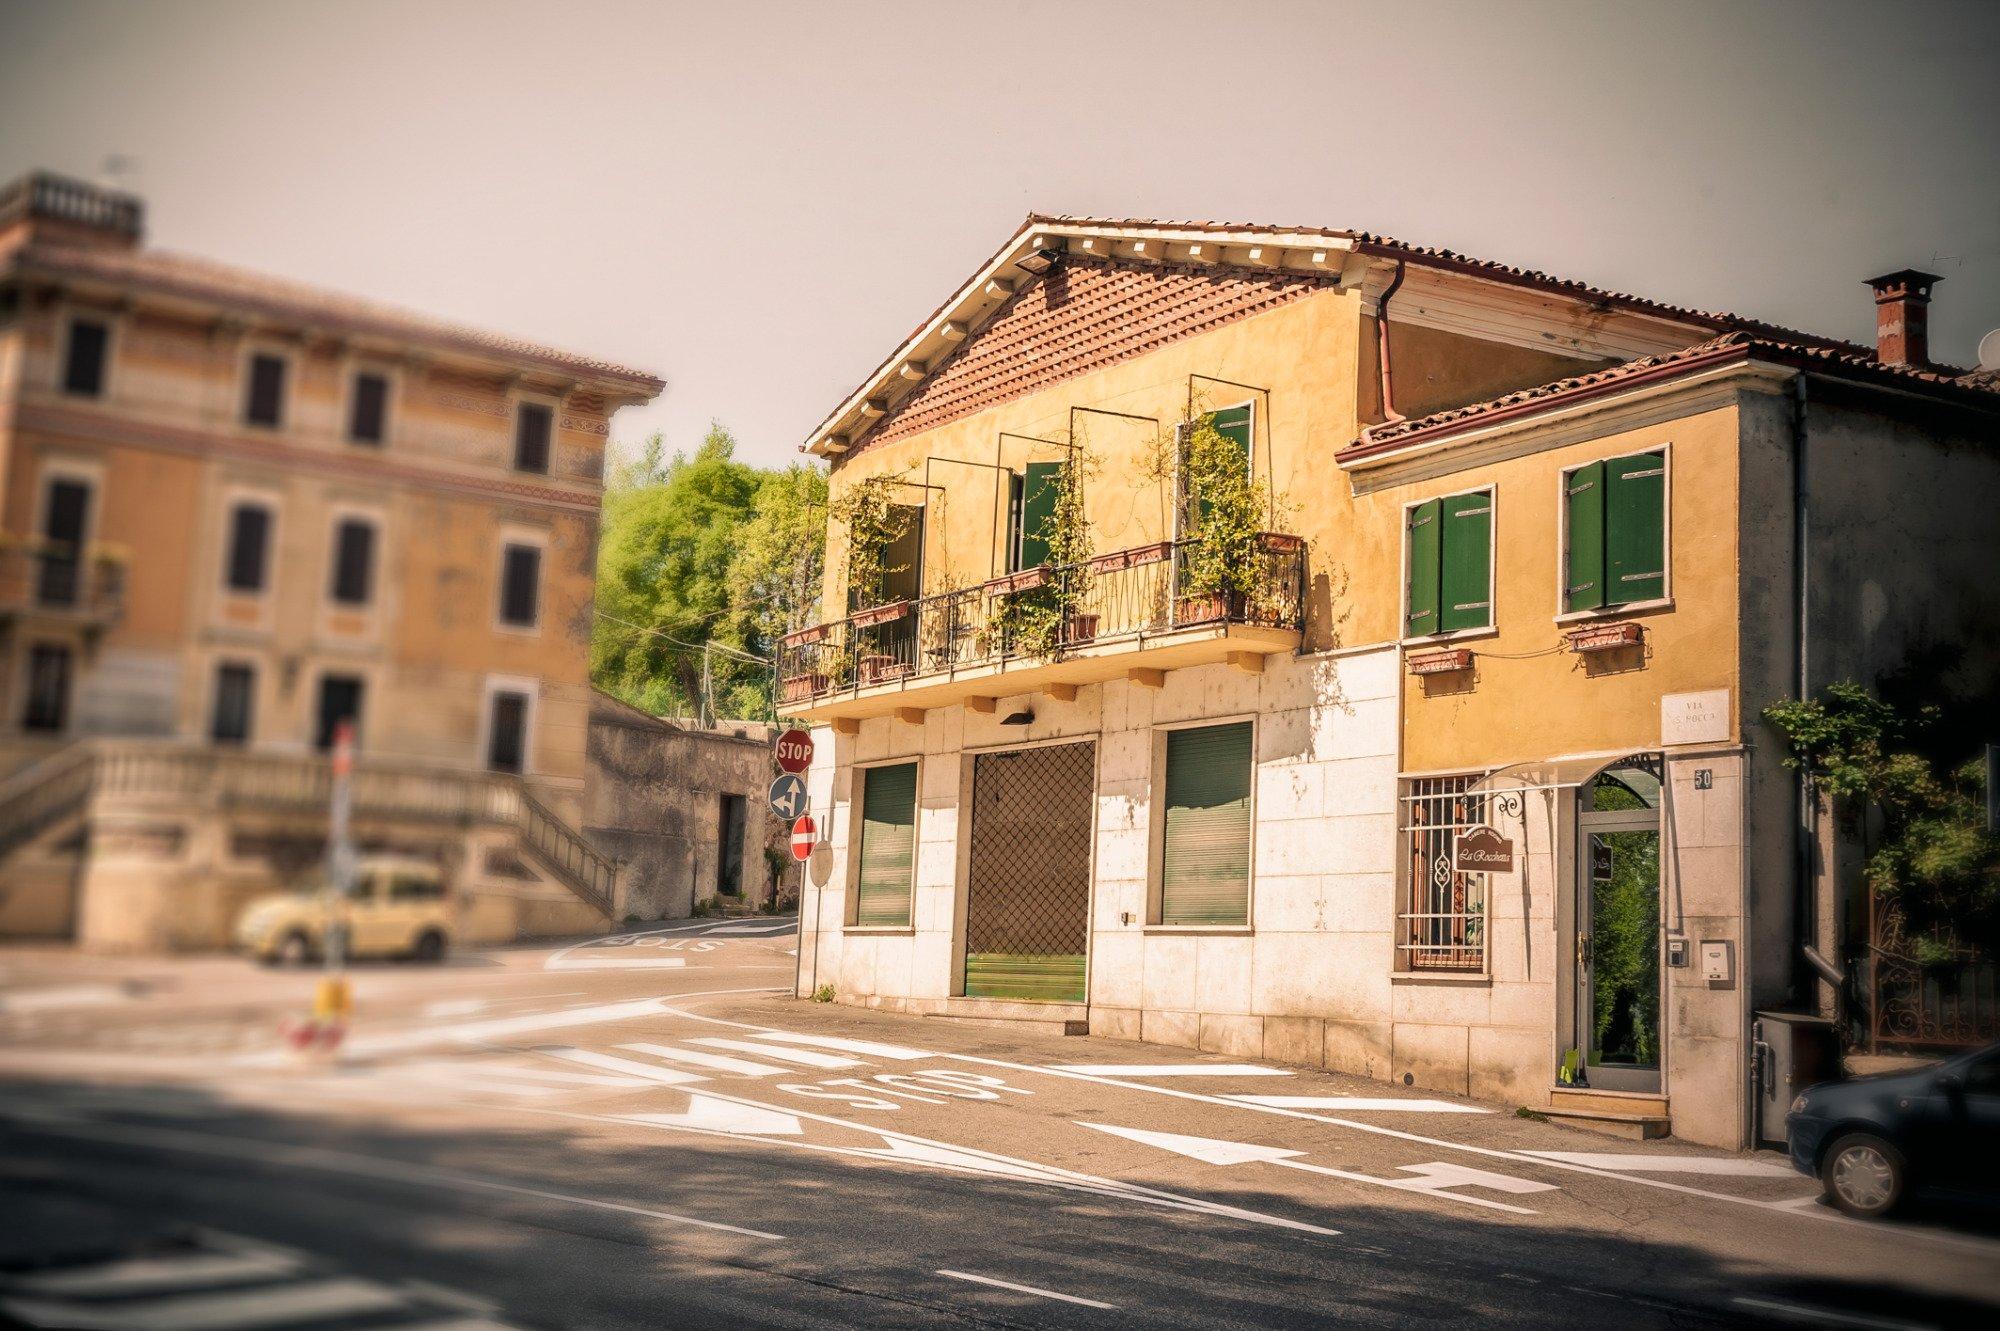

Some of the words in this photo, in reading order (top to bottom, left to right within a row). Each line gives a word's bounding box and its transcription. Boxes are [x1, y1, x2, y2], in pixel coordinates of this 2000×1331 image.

[779, 742, 812, 761] STOP
[1695, 771, 1709, 785] 50
[1459, 849, 1473, 860] La
[601, 936, 725, 952] STOP
[776, 1070, 1035, 1110] STOP
